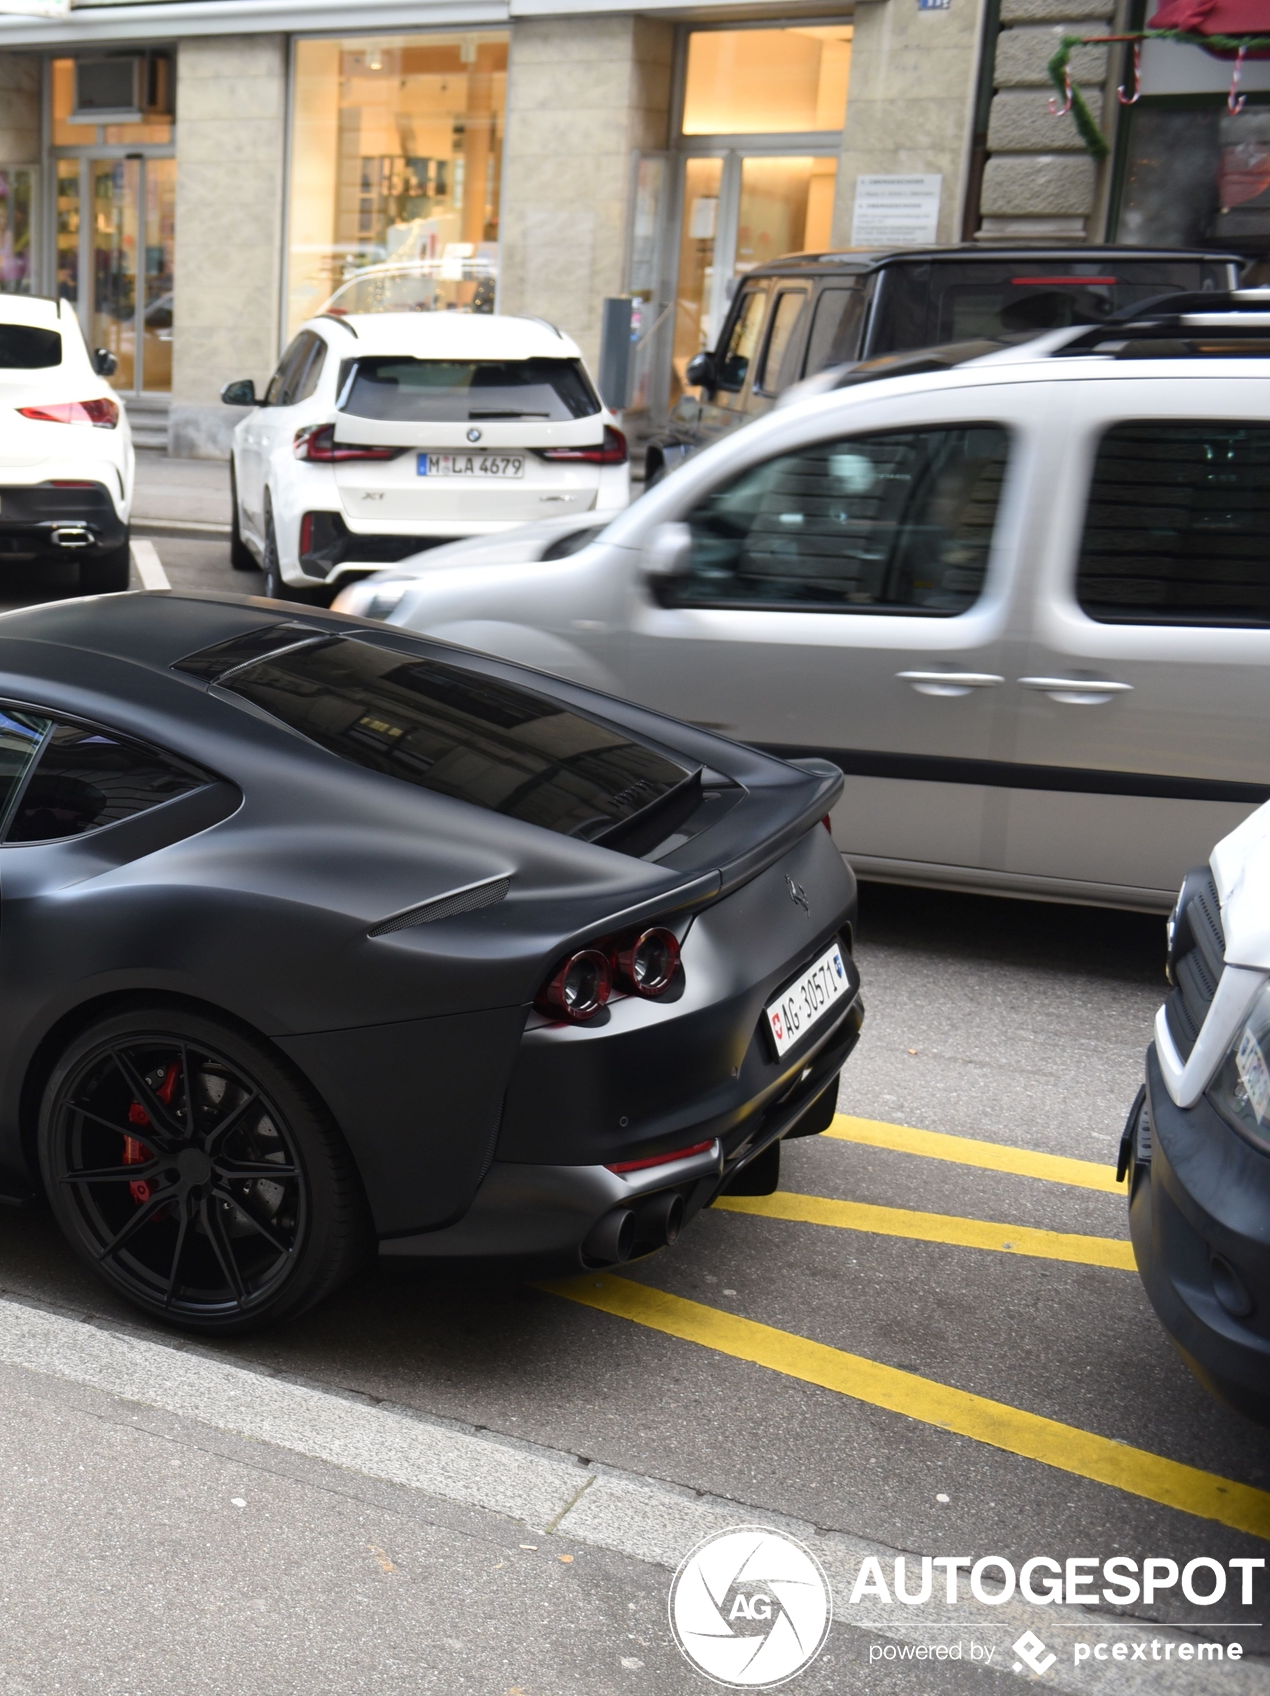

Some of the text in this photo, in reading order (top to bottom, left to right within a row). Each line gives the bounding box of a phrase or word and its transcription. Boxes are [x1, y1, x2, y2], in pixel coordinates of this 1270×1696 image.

[428, 456, 522, 475] M LA 4679
